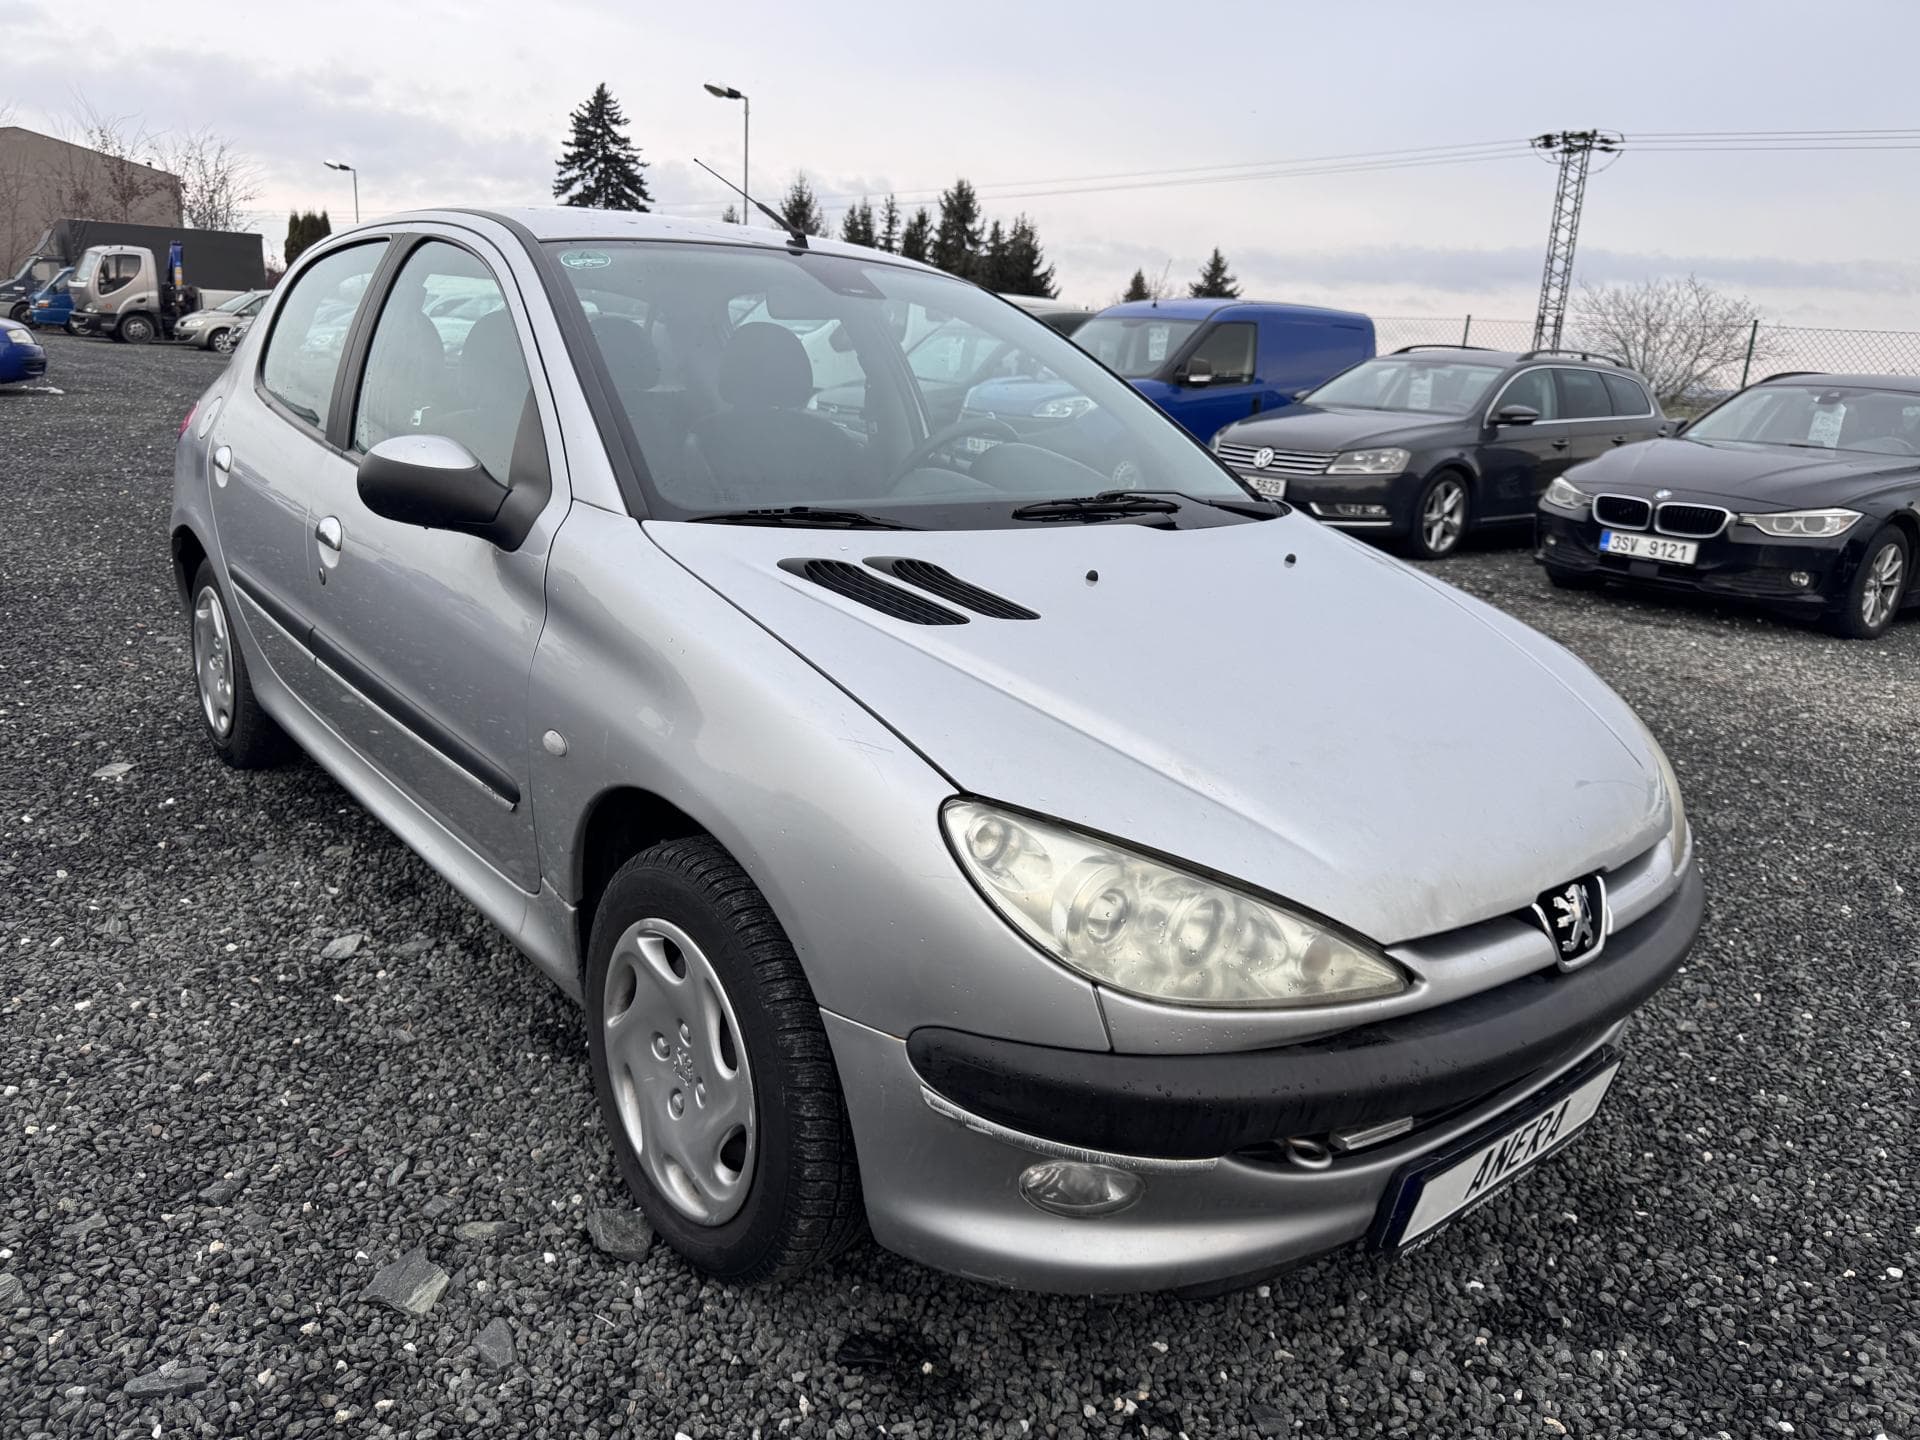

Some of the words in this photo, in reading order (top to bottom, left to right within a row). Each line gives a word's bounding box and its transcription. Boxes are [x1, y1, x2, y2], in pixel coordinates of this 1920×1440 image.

[1611, 535, 1639, 553] 3SV
[1648, 540, 1688, 561] 9121
[1463, 1097, 1572, 1200] ANERA
